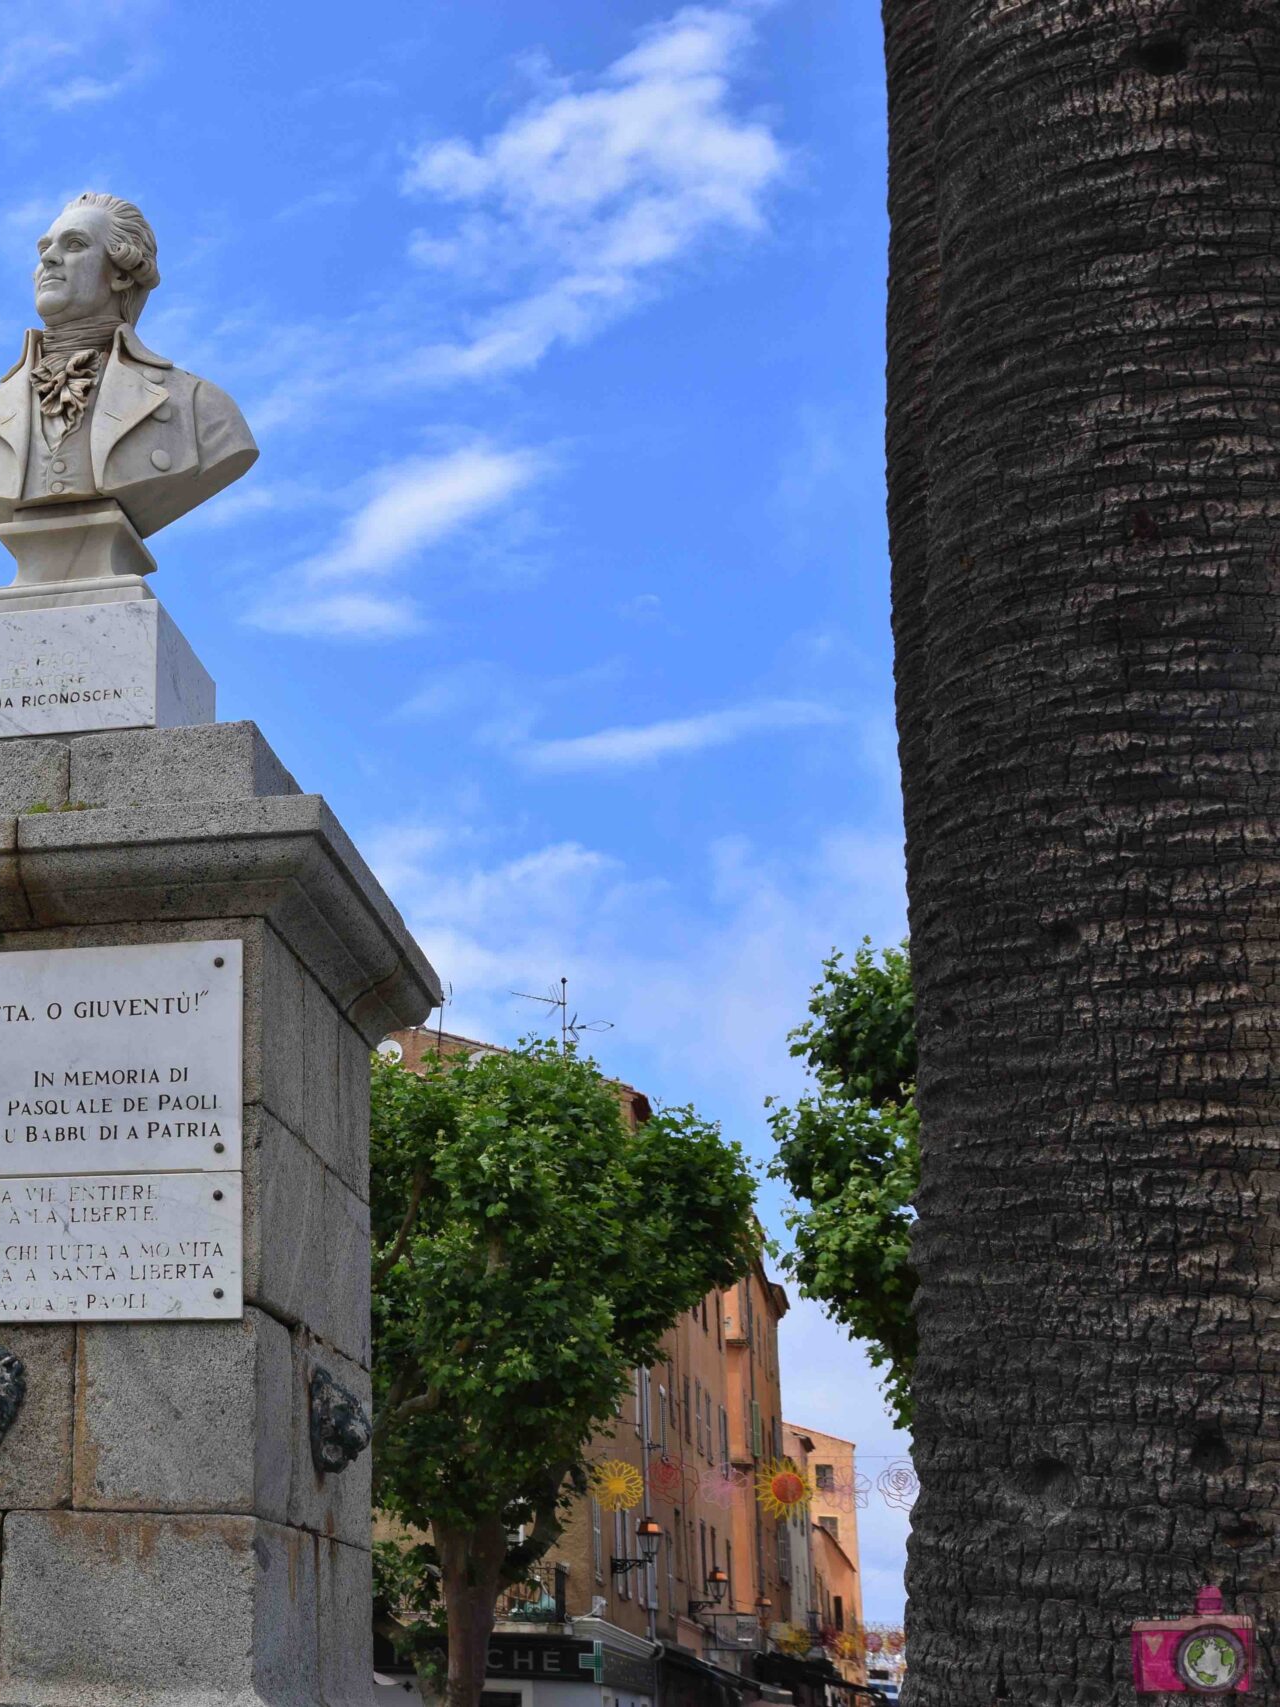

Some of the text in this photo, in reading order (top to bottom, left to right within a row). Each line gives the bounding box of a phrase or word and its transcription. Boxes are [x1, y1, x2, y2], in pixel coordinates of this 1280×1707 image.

[46, 1002, 62, 1020] O
[33, 1067, 189, 1087] IN MEMORIA DI
[7, 1098, 113, 1116] PASQUALE
[123, 1097, 148, 1113] DE
[4, 1122, 222, 1143] U BABBU DI A PATRIA
[25, 1186, 57, 1203] VIE
[32, 1208, 58, 1224] LA
[46, 1243, 108, 1260] TUTTA
[118, 1244, 130, 1259] A
[179, 1241, 224, 1257] VITA
[25, 1267, 37, 1282] A
[51, 1264, 117, 1282] SANTA
[86, 1293, 147, 1309] PAOLI
